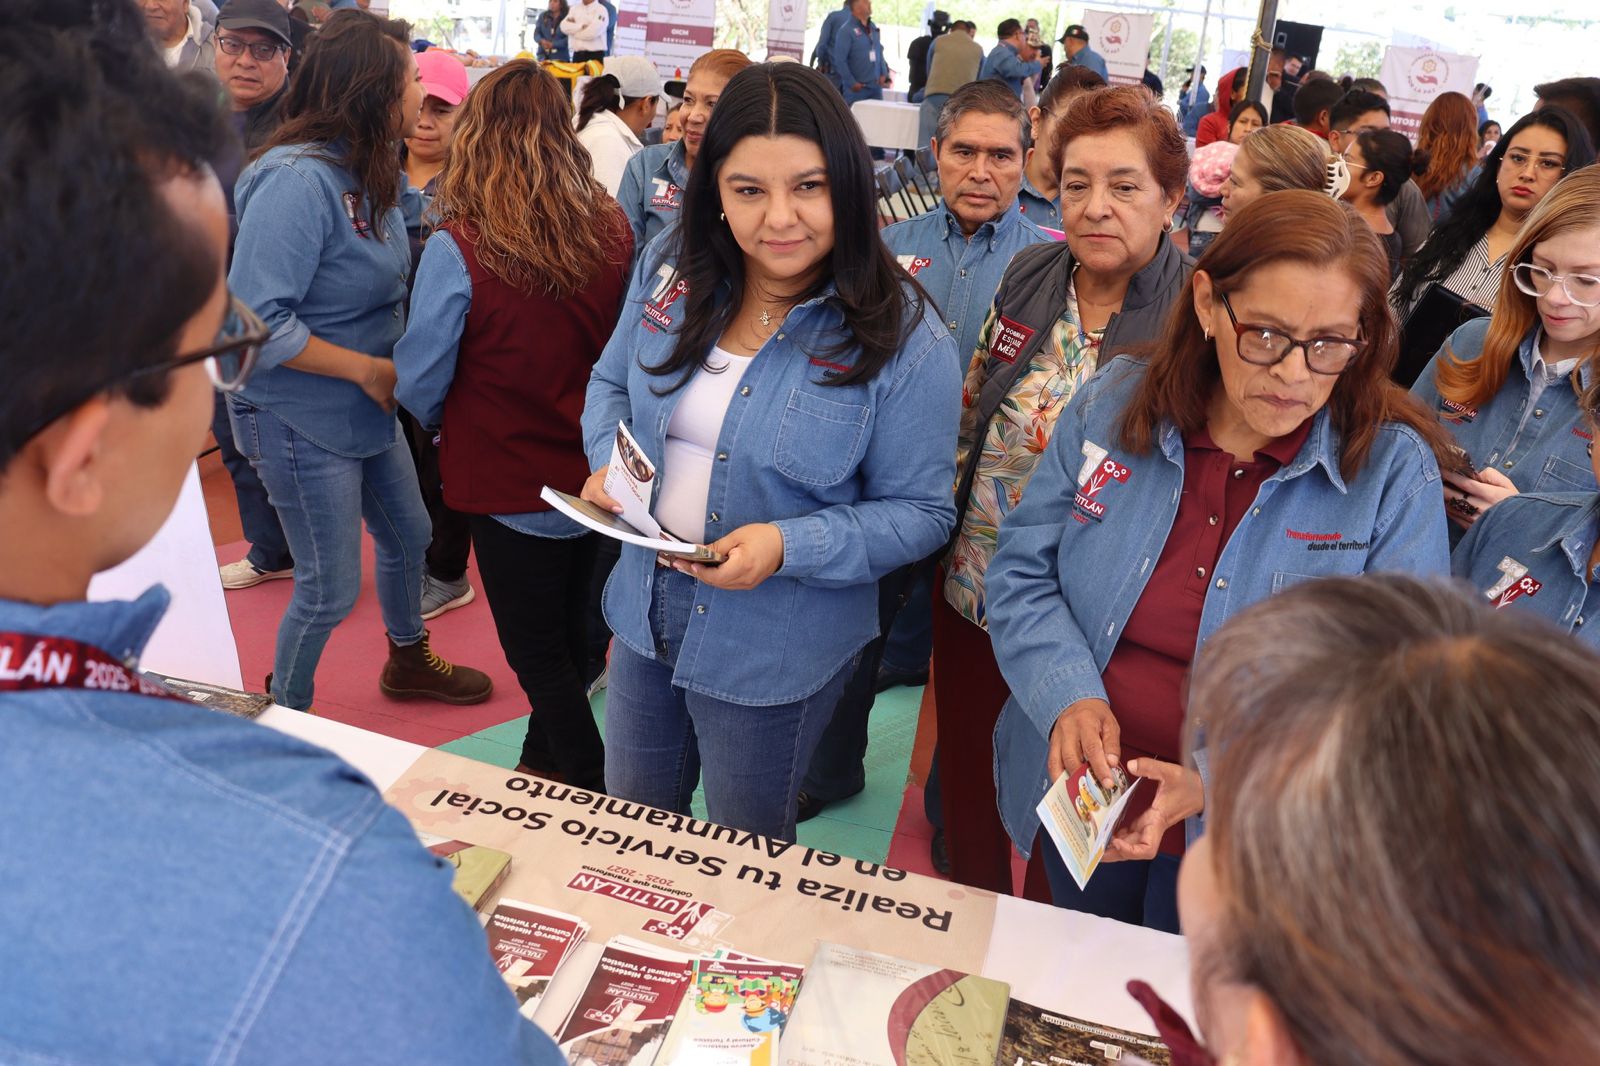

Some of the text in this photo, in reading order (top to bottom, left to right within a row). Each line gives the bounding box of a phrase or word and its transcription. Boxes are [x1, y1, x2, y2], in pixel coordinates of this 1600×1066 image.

[1307, 541, 1330, 552] desde
[1330, 541, 1337, 551] el
[505, 777, 907, 882] en el Ayuntamiento
[430, 789, 953, 932] Realiza tu Servicio Social
[606, 865, 637, 877] 2027
[581, 866, 693, 898] Gobierno que Transforma
[644, 874, 675, 887] 2025
[537, 925, 571, 937] Cultural
[647, 968, 682, 978] Cultural
[606, 987, 654, 1002] TULTITLÁN
